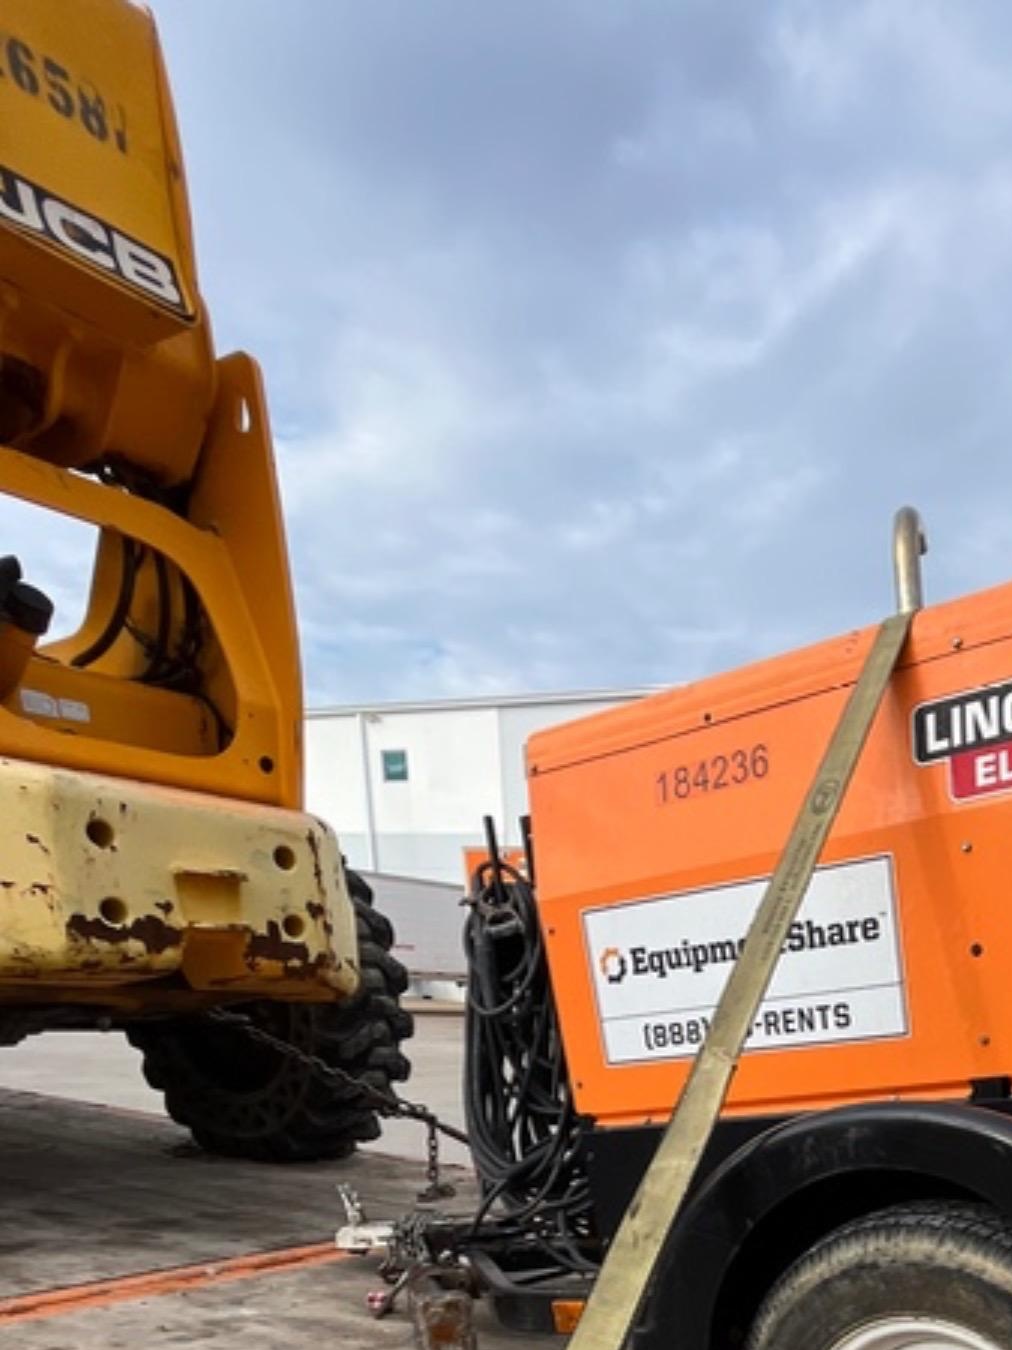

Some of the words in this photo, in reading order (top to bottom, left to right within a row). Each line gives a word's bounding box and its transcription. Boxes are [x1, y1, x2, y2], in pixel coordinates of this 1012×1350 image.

[0, 178, 182, 305] JCB
[656, 743, 769, 803] 184236
[629, 916, 881, 979] EquipmShare
[744, 1003, 851, 1037] -RENTS
